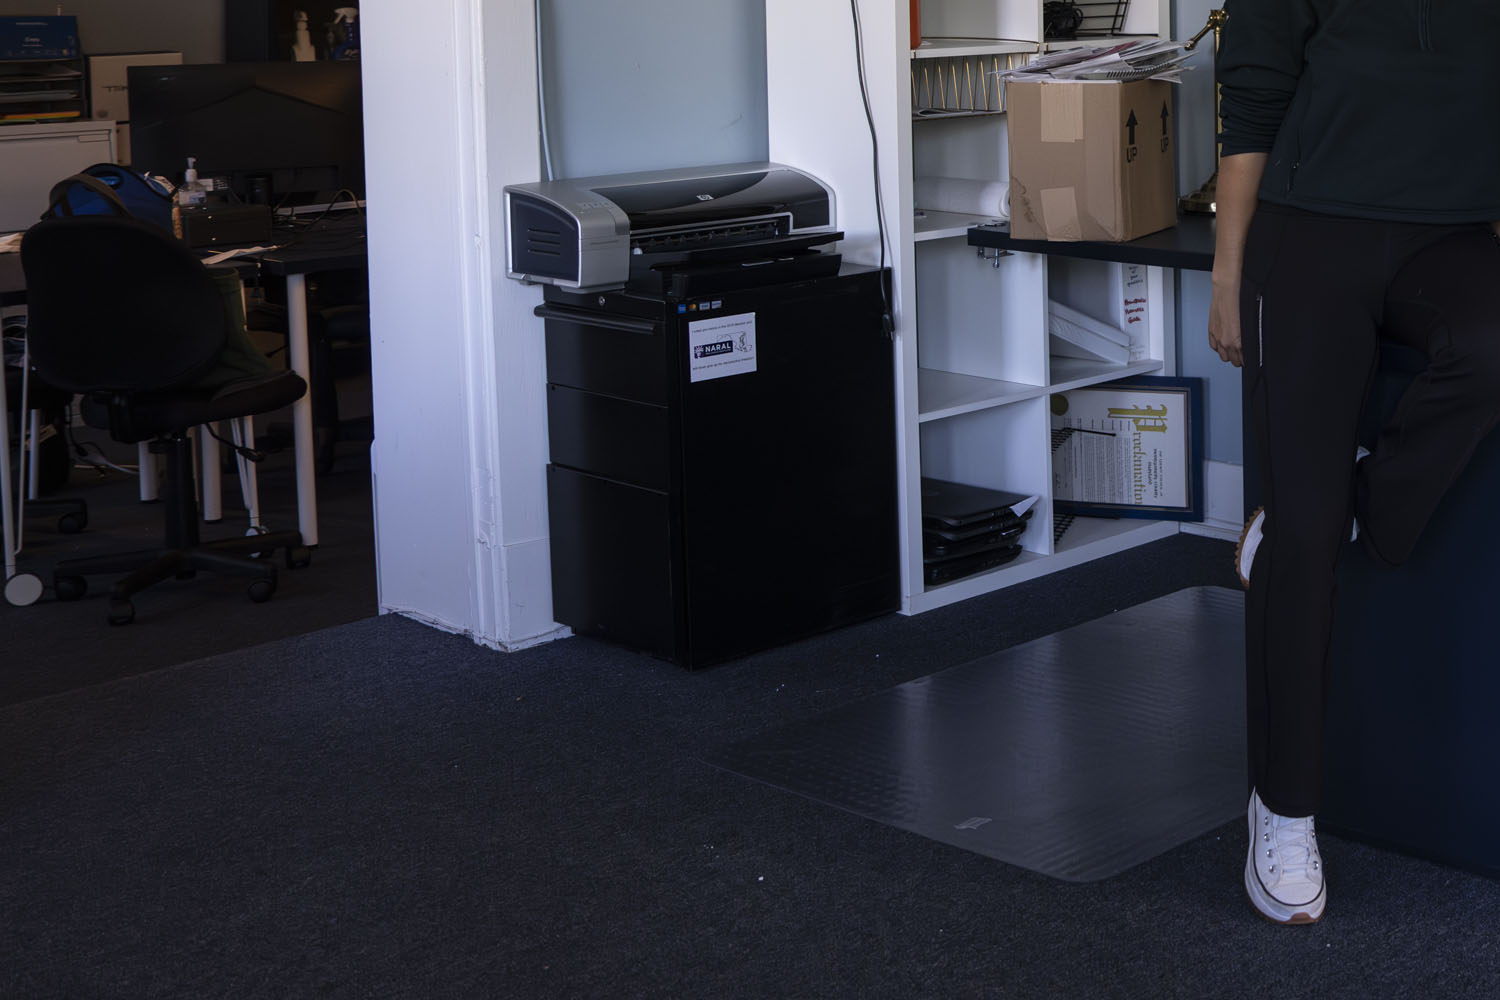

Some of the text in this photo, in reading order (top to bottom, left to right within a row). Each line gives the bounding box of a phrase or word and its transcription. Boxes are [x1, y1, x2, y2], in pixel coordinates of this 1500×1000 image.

[1161, 136, 1169, 152] UP
[1127, 146, 1137, 163] UP
[705, 342, 731, 353] NARAL
